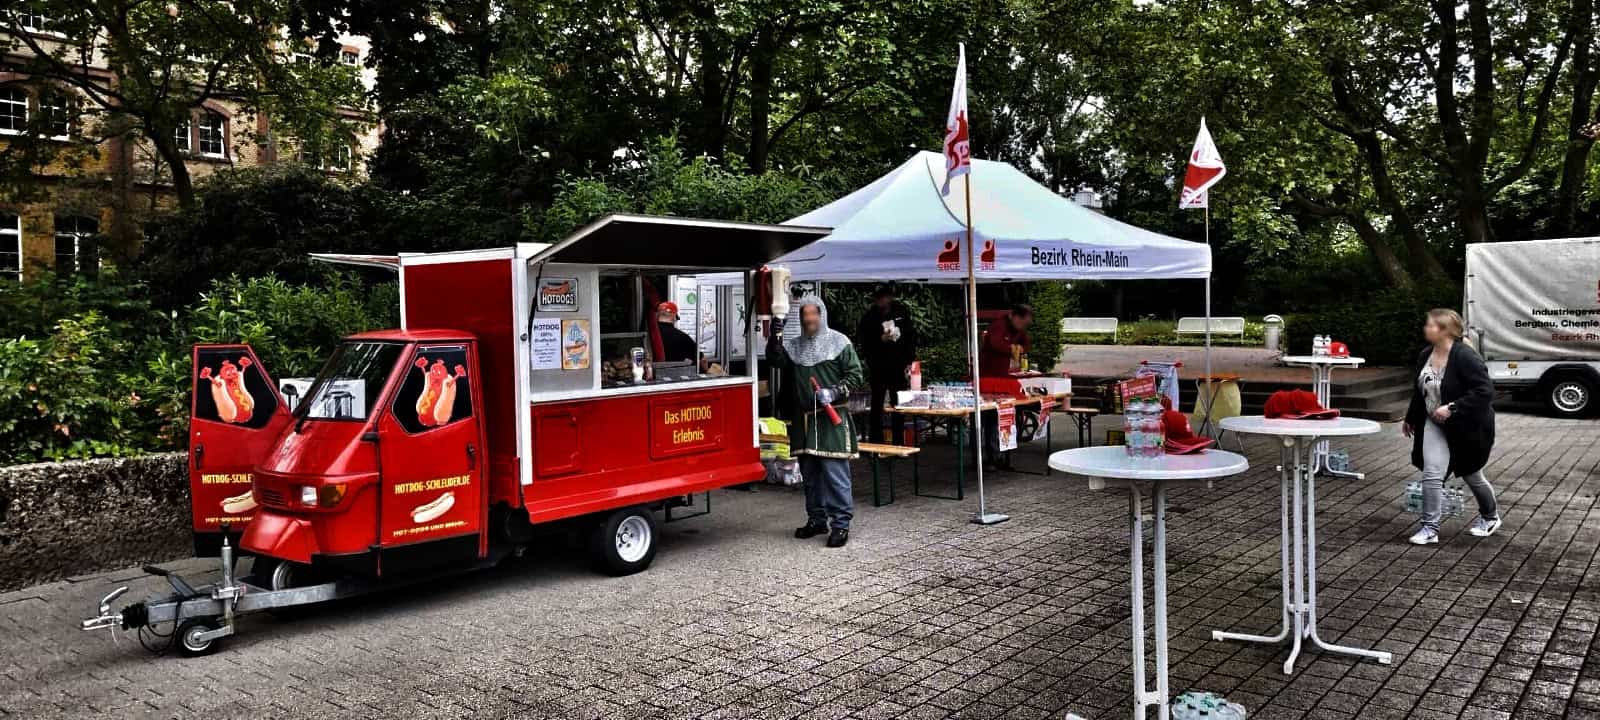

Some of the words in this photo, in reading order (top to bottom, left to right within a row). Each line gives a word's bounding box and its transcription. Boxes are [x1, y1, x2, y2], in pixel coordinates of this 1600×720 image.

[1031, 247, 1067, 265] Bezirk
[1071, 248, 1129, 267] Rhein-Main
[542, 294, 574, 305] HOTDOGS
[1515, 320, 1558, 328] Bergbau,
[665, 410, 680, 424] Das
[681, 405, 712, 422] HOTDOG
[673, 427, 704, 444] Erlebnis
[394, 474, 471, 495] HOTDOG-SCHLEUDER.DE
